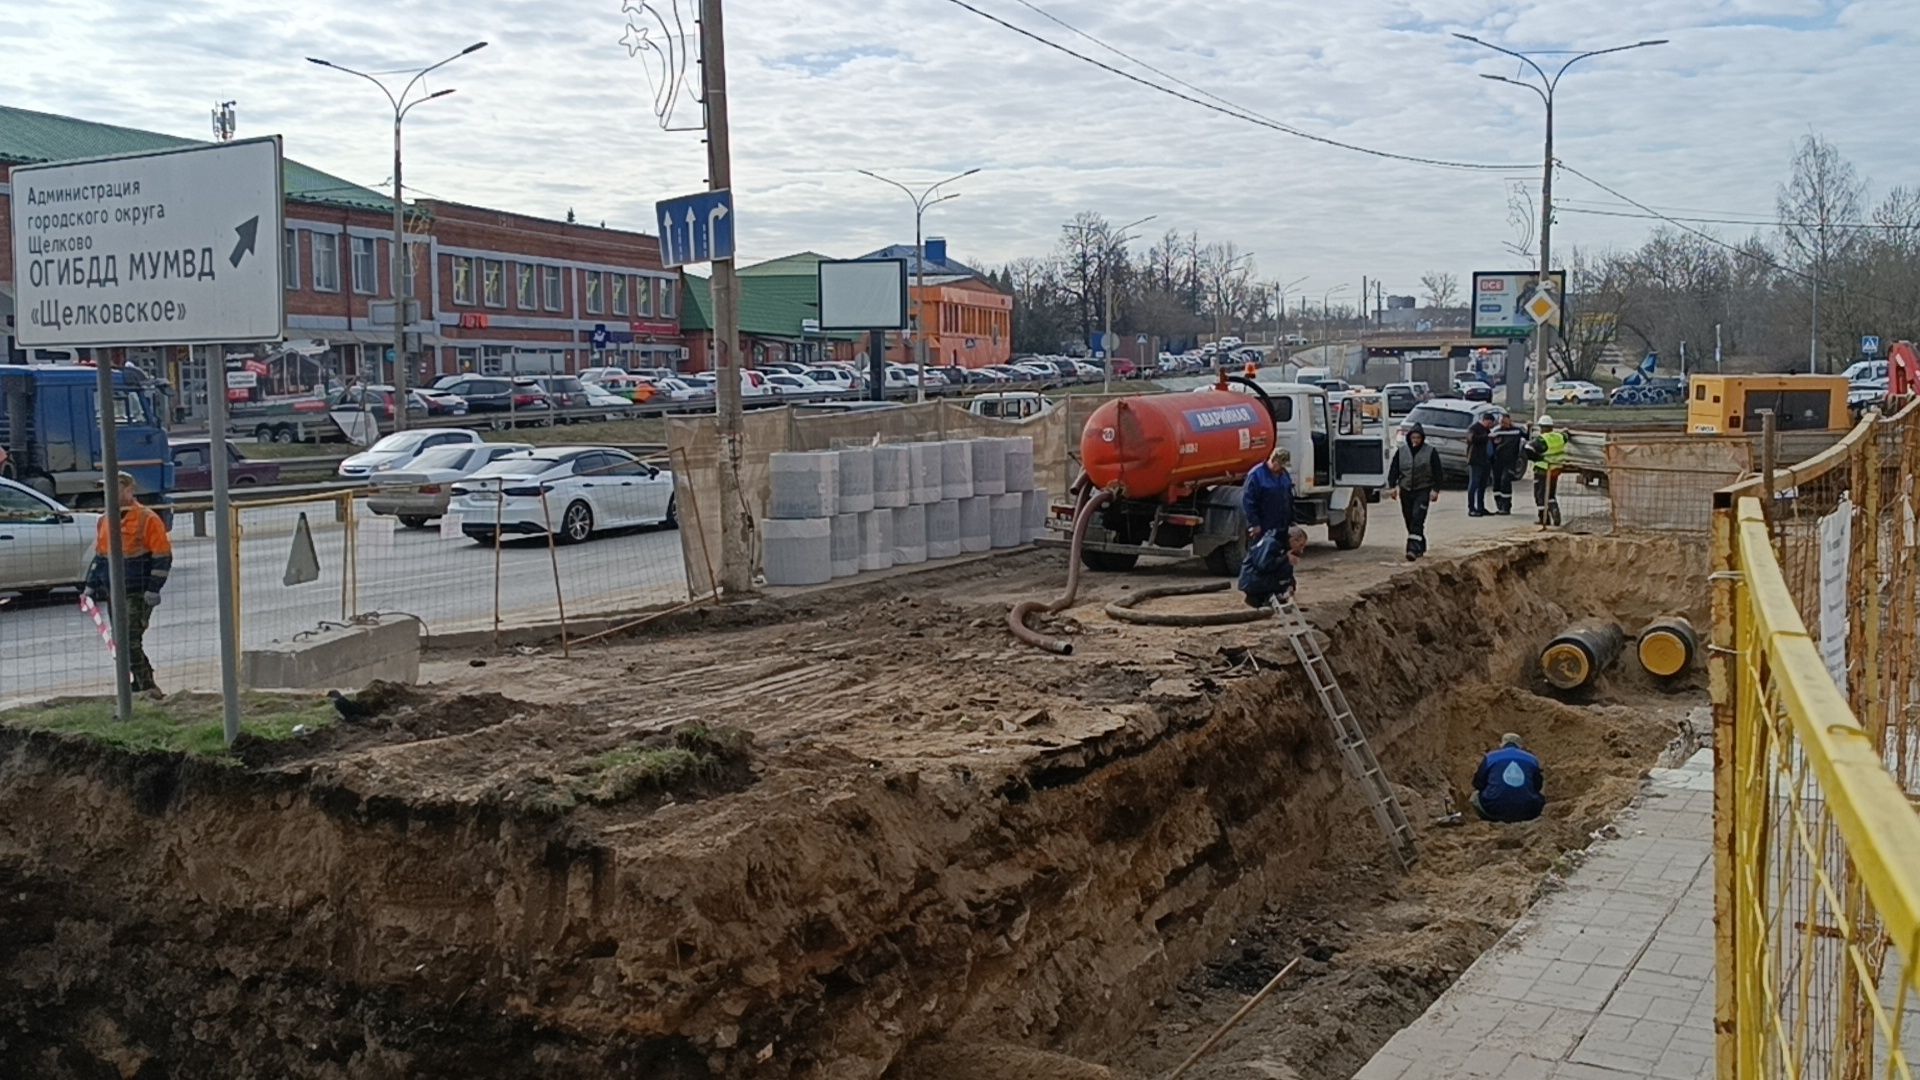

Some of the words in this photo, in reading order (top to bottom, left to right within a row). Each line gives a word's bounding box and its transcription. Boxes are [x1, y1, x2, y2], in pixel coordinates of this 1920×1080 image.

[27, 181, 140, 205] Администрация
[28, 212, 109, 231] городского
[115, 204, 165, 226] округа
[28, 238, 93, 255] Щелково
[29, 254, 118, 288] ОГИБДД
[129, 247, 215, 281] МУМВД
[30, 299, 187, 330] «Щелковское»
